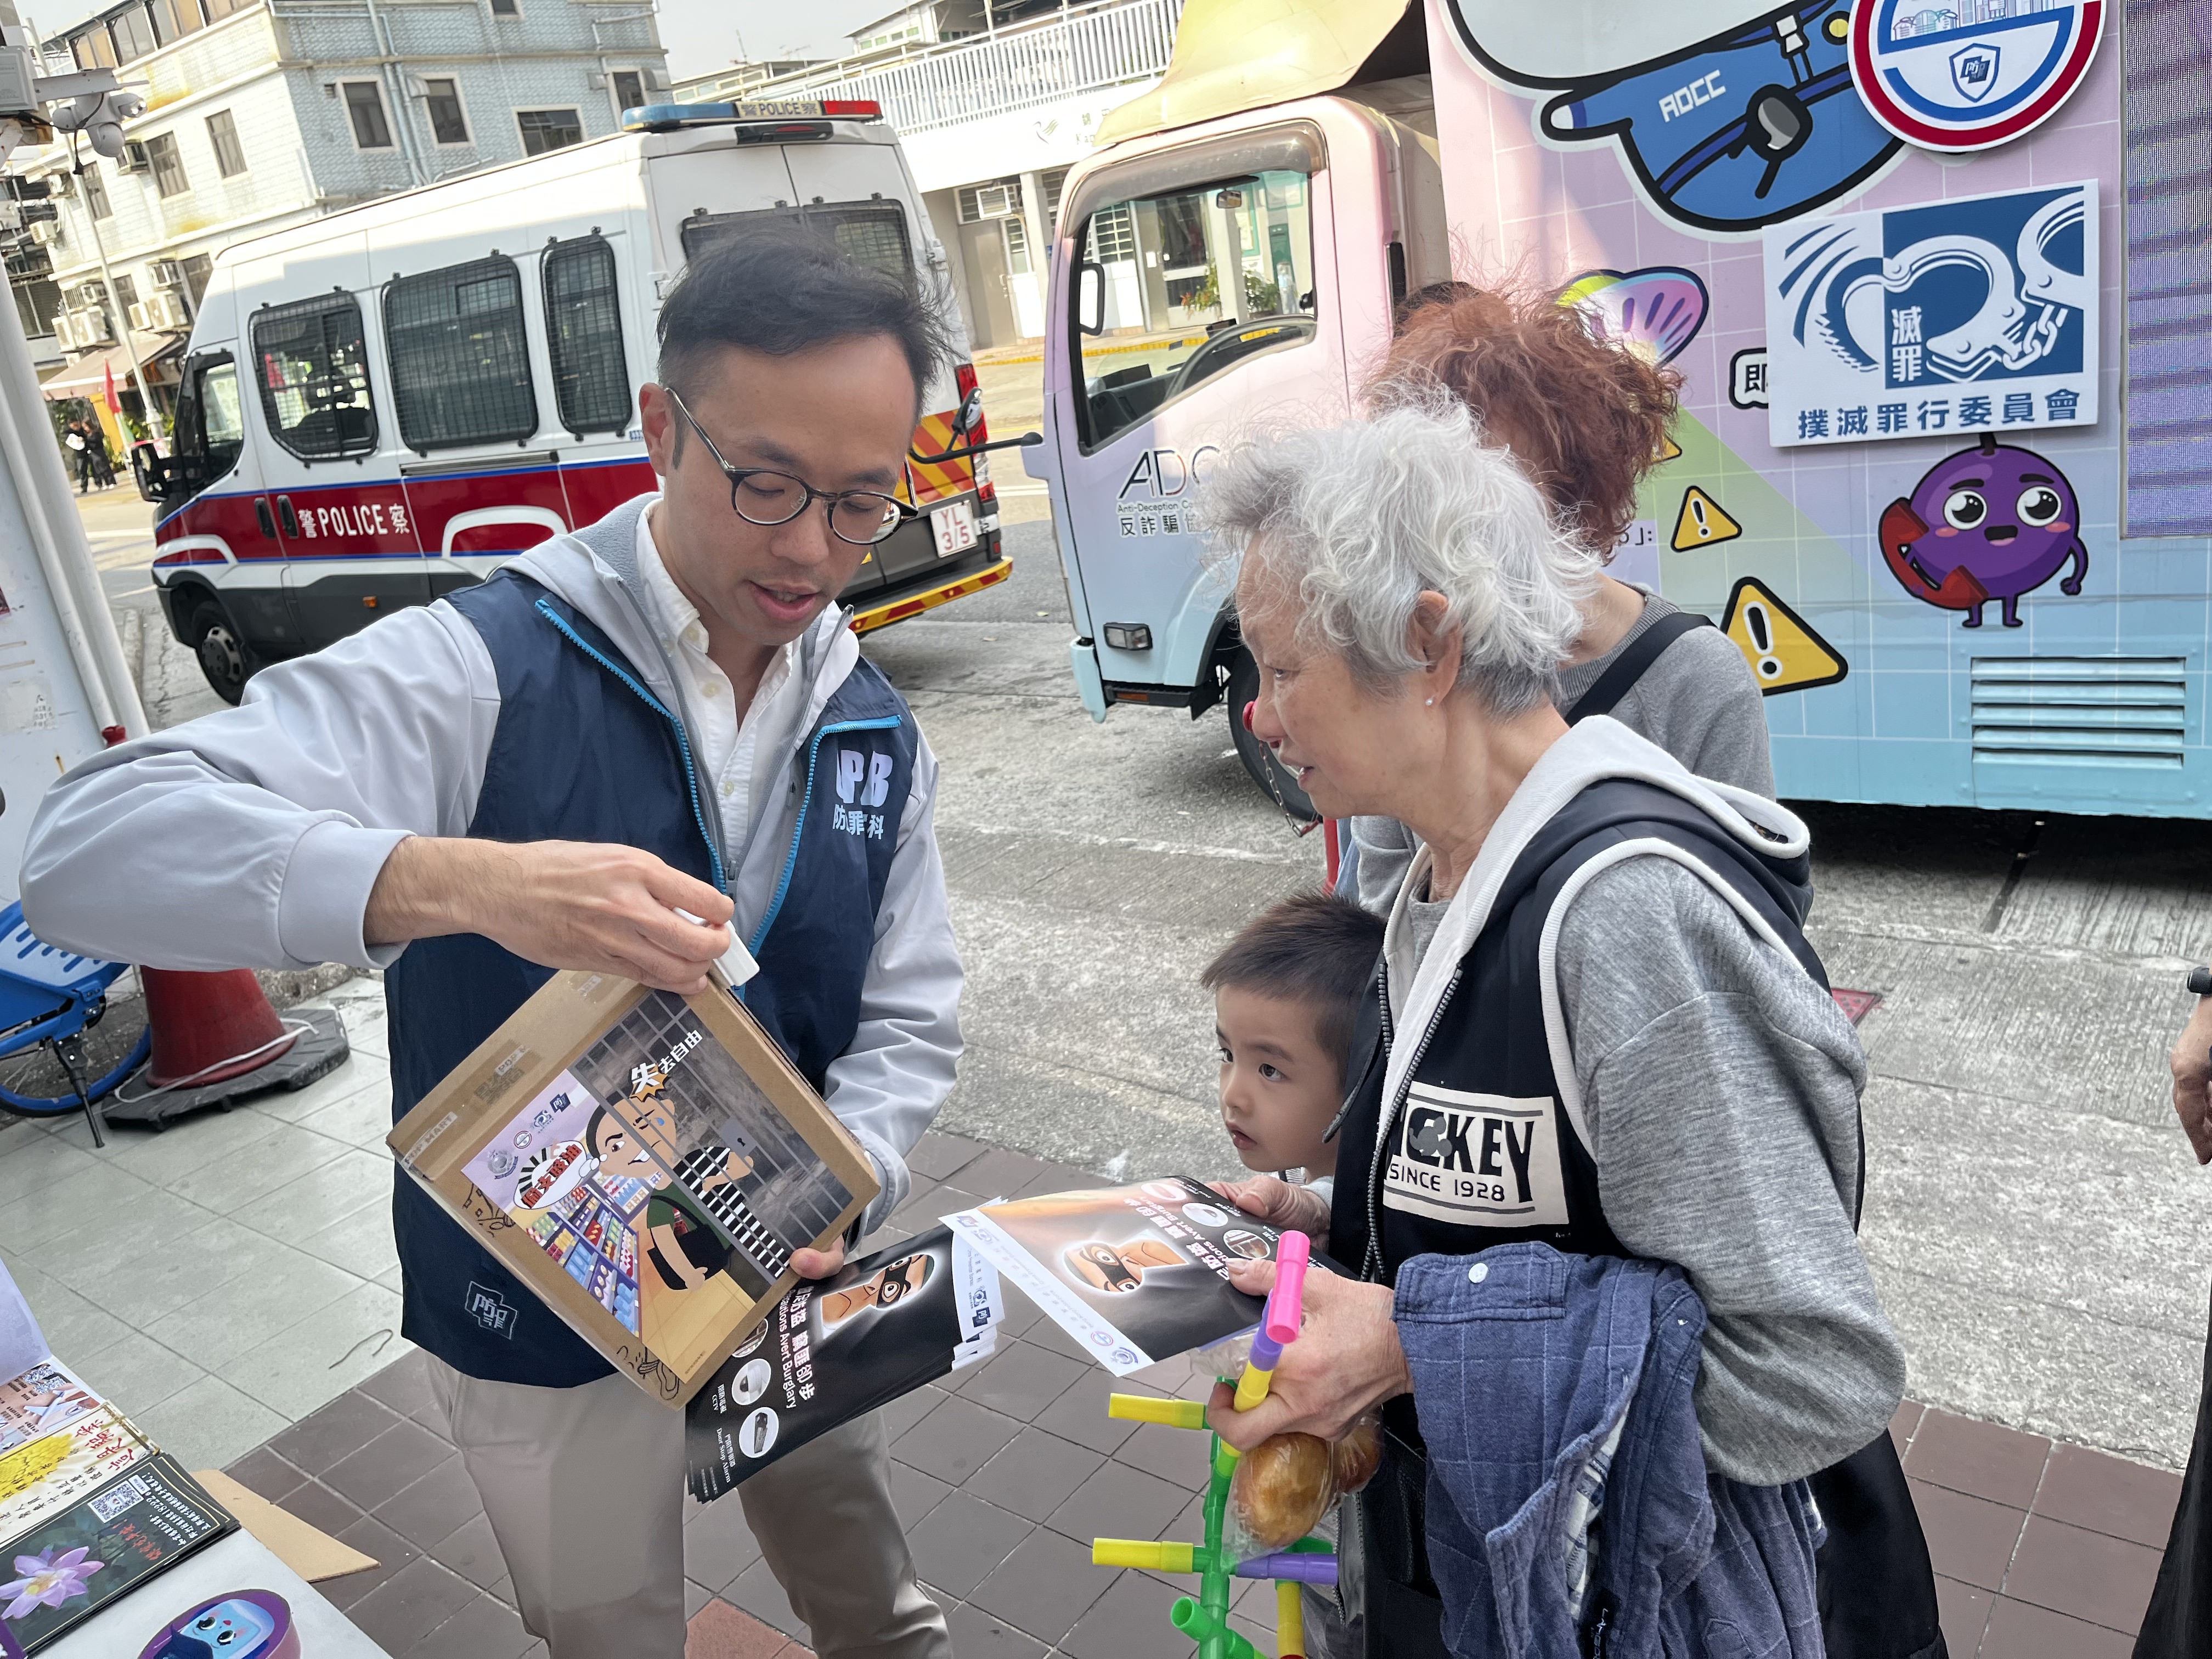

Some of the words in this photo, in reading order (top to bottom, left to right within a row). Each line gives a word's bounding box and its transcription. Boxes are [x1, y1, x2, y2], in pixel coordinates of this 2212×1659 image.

[759, 103, 801, 116] POLICE
[1658, 69, 1726, 123] ADCC
[1891, 305, 1922, 382] 滅罪
[1797, 388, 2080, 439] 撲滅罪行委員會
[298, 508, 318, 539] 警
[317, 503, 389, 537] POLICE
[388, 503, 410, 534] 察
[940, 507, 963, 530] YL
[1117, 501, 1178, 515] Anti-Deception
[832, 803, 885, 840] 防罪科
[631, 1029, 703, 1094] 失去自由
[1404, 1107, 1535, 1204] CKEY
[1389, 1163, 1441, 1192] SINCE
[1454, 1179, 1505, 1202] 1928
[1176, 1221, 1206, 1241] Avert
[780, 1332, 792, 1362] Avert
[782, 1360, 797, 1409] Burglary
[722, 1462, 731, 1483] Alarm
